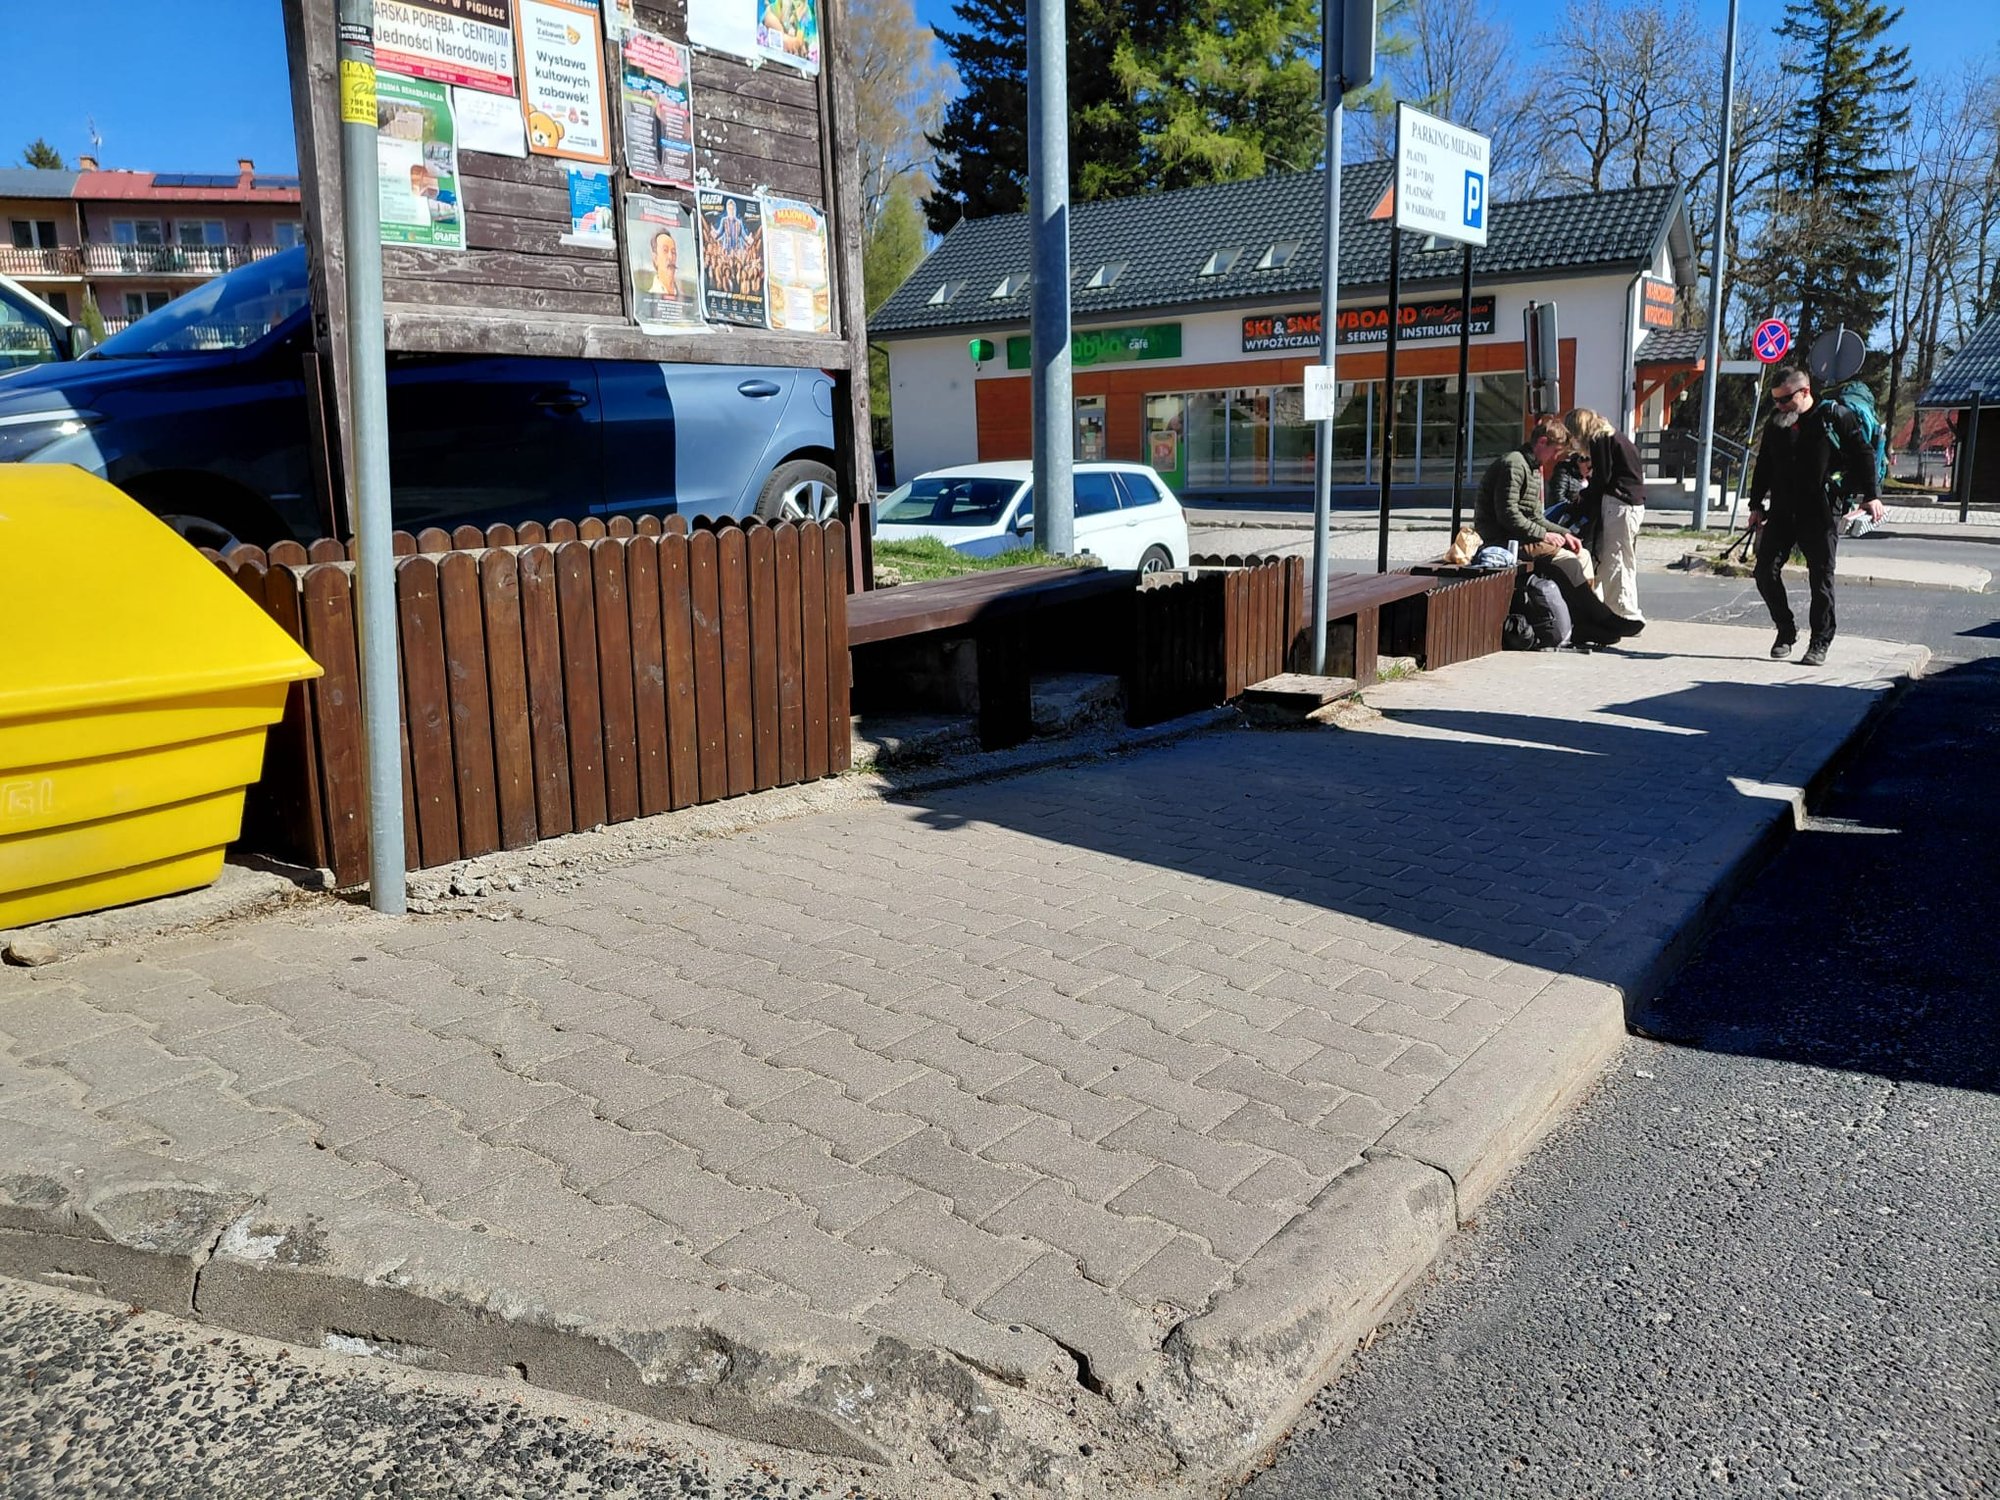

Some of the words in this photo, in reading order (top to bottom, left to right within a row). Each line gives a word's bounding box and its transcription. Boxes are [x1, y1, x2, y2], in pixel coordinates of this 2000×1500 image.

[466, 1, 505, 21] PIGUŁCE
[374, 1, 410, 25] ARSKA
[413, 11, 455, 35] PORĘBA
[462, 21, 509, 49] CENTRUM
[536, 17, 565, 30] Muzeum
[375, 24, 433, 52] Jedności
[436, 38, 498, 71] Narodowej
[500, 55, 508, 70] 5
[536, 50, 586, 71] Wystawa
[535, 66, 590, 89] kultowych
[538, 85, 590, 104] zabawek!
[1411, 121, 1449, 150] PARKING
[1451, 137, 1482, 161] MIEJSKI
[1244, 318, 1272, 337] SKI
[1273, 320, 1285, 336] &
[1346, 327, 1388, 343] SERWIS
[1128, 338, 1149, 350] café
